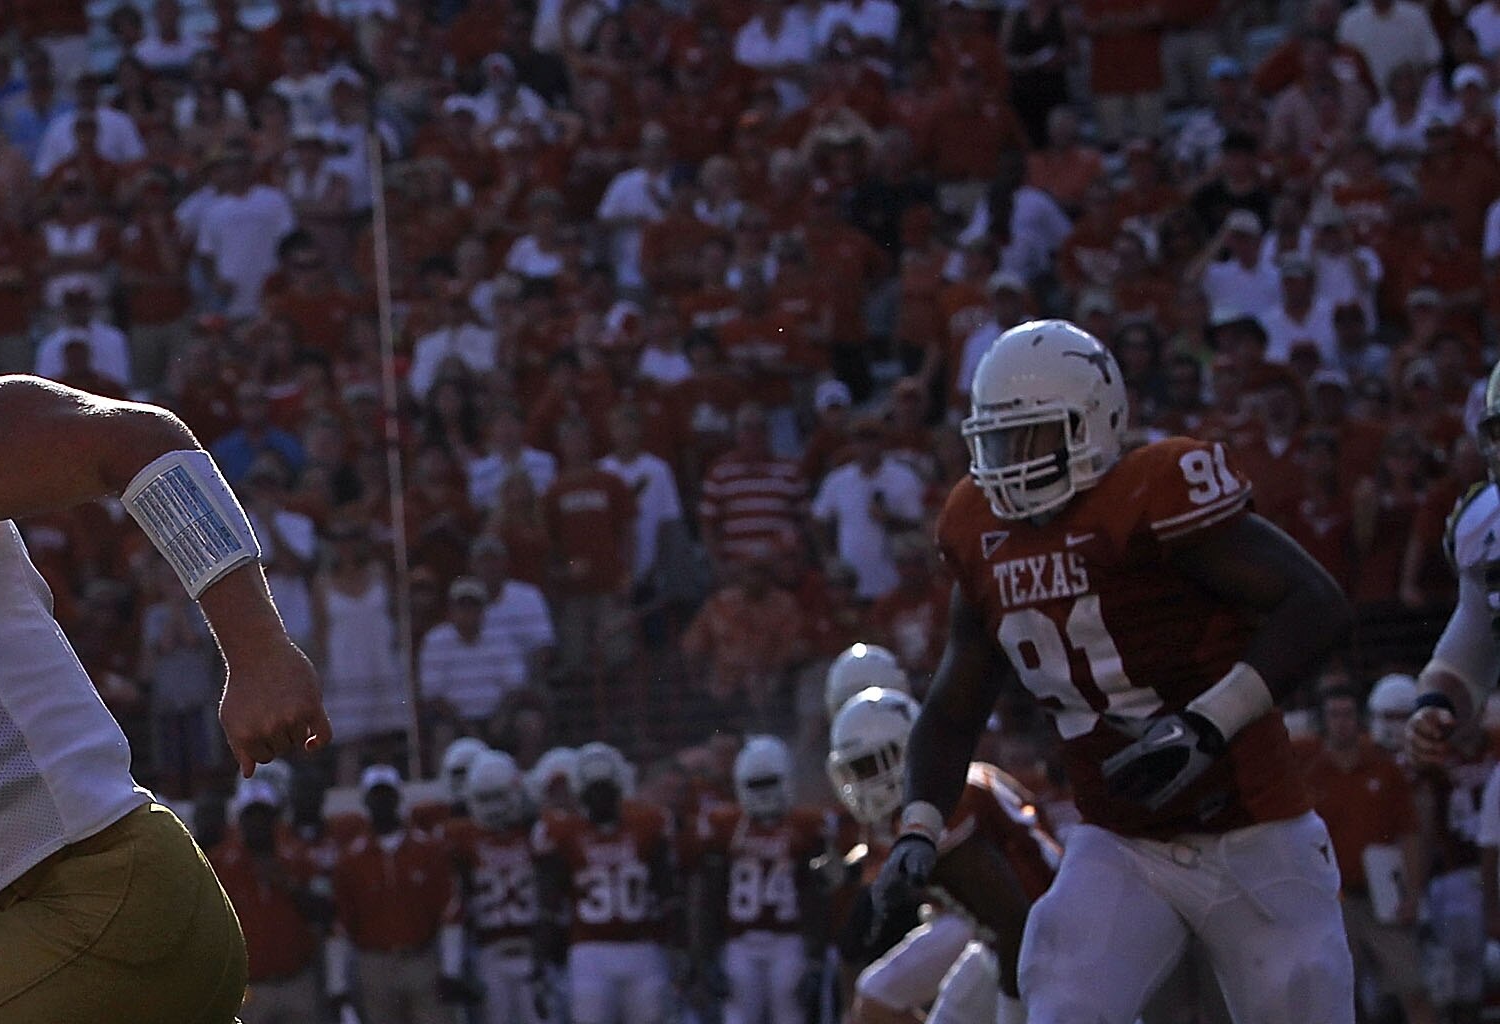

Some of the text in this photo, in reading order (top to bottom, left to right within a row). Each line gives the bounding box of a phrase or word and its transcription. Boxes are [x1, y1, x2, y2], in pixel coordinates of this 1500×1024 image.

[1178, 442, 1240, 505] 91
[993, 552, 1090, 608] TEXAS
[997, 594, 1165, 740] 91
[575, 862, 650, 923] 30
[728, 858, 797, 923] 84
